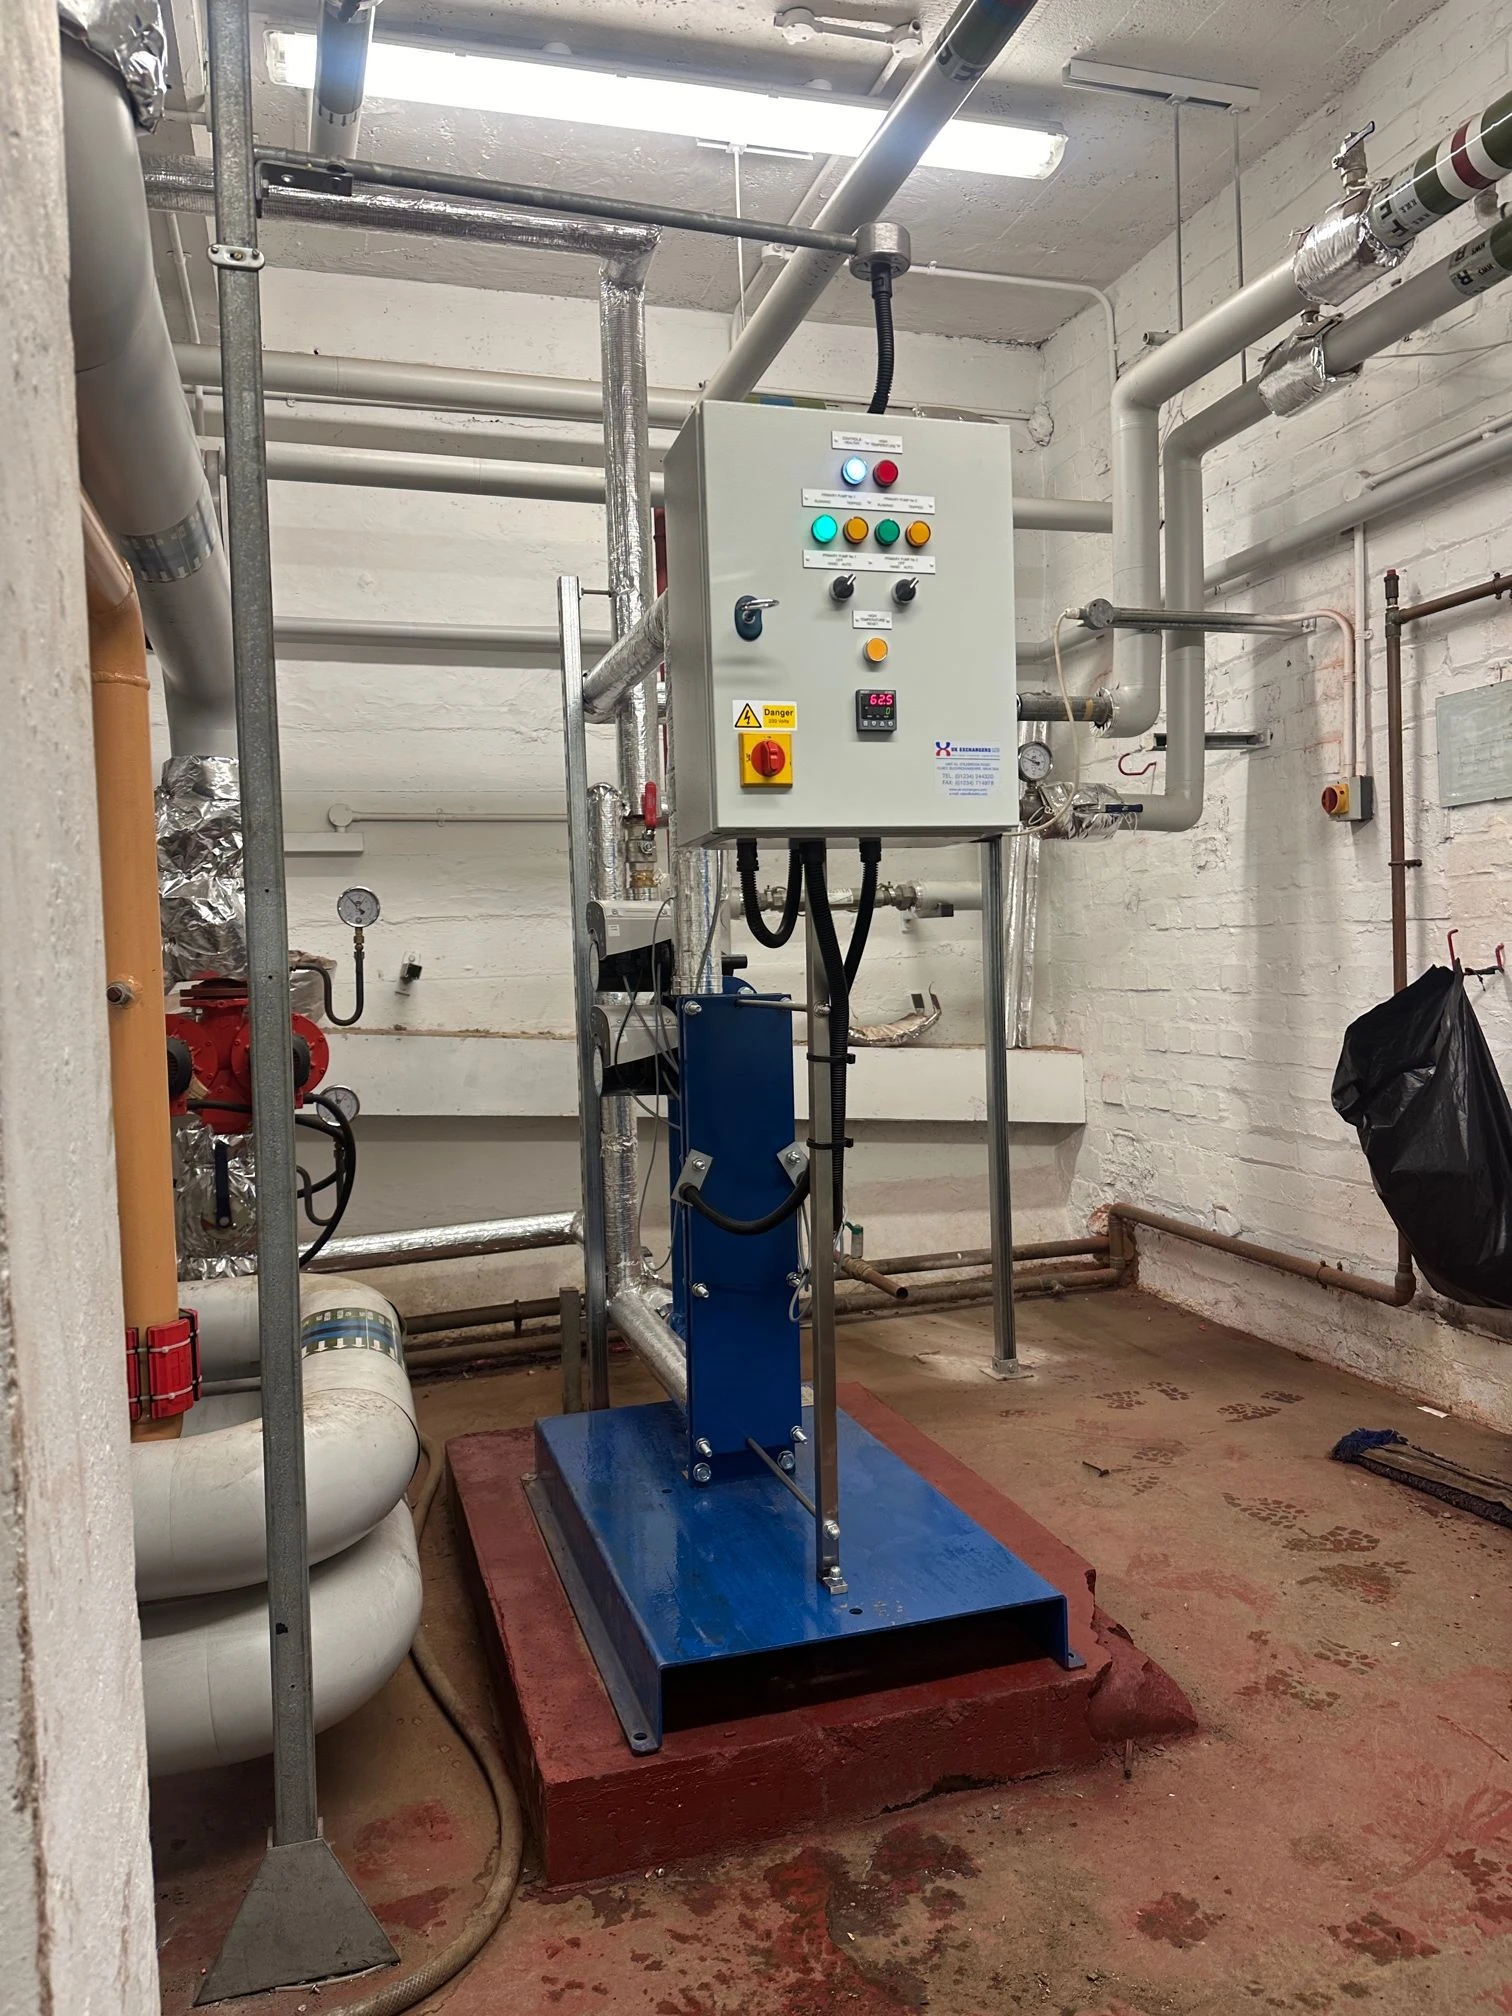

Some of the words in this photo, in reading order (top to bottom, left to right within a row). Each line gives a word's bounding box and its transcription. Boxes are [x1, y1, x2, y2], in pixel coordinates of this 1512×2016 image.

[1457, 269, 1474, 286] R
[870, 694, 893, 705] 62.5
[764, 708, 794, 718] Danger
[885, 707, 891, 715] 0
